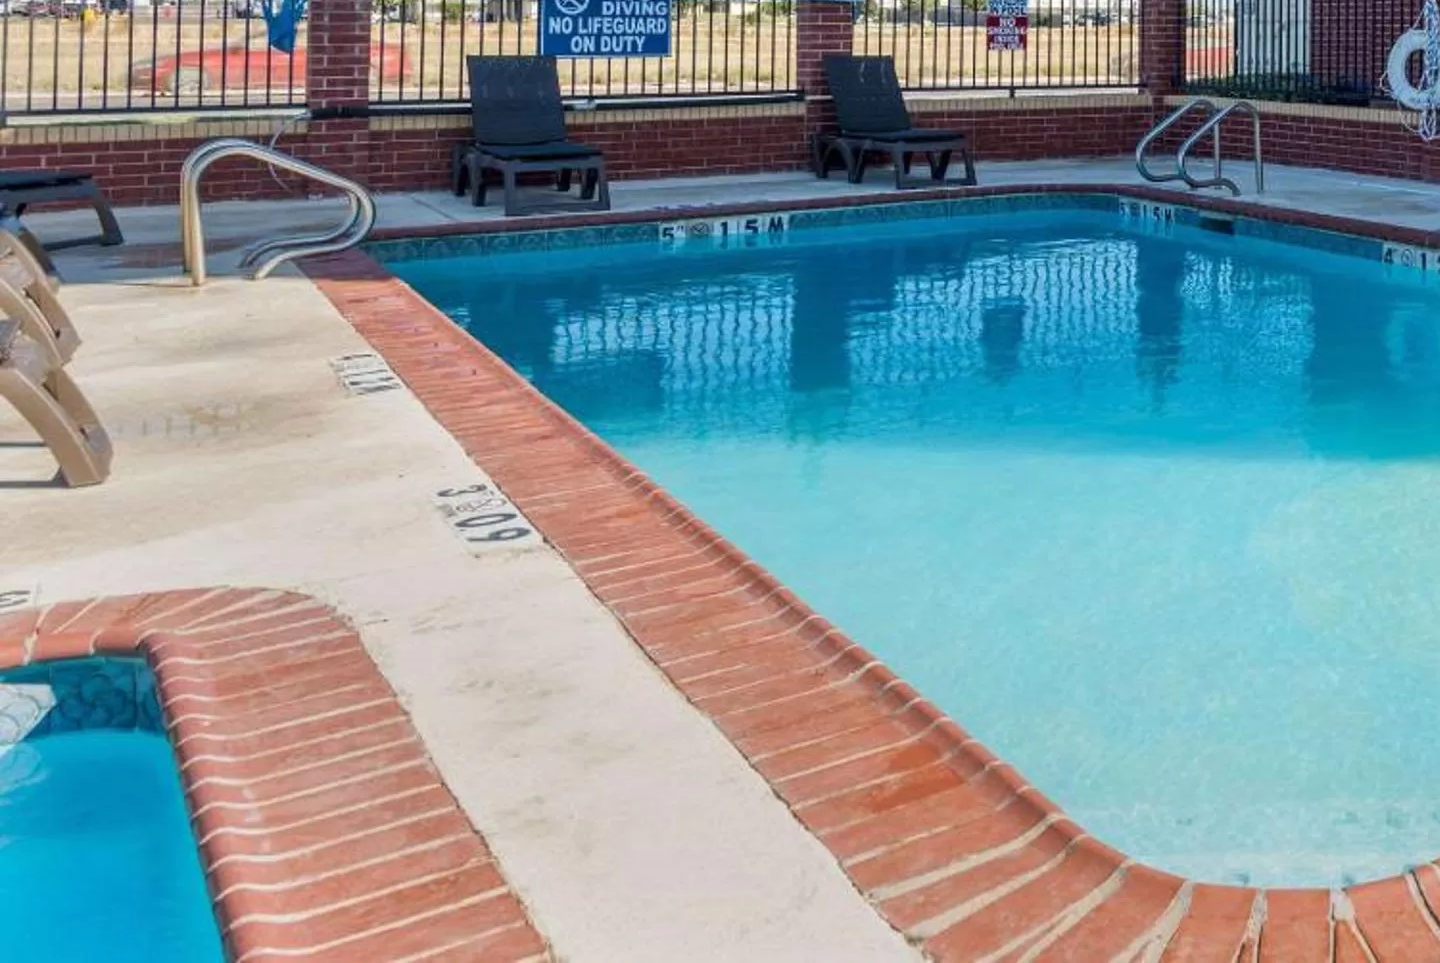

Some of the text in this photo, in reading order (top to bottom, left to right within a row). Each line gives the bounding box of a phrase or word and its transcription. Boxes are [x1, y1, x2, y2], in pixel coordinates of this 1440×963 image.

[602, 1, 668, 16] DIVING
[548, 17, 667, 34] NO LIFEGUARD
[571, 36, 646, 53] ON DUTY
